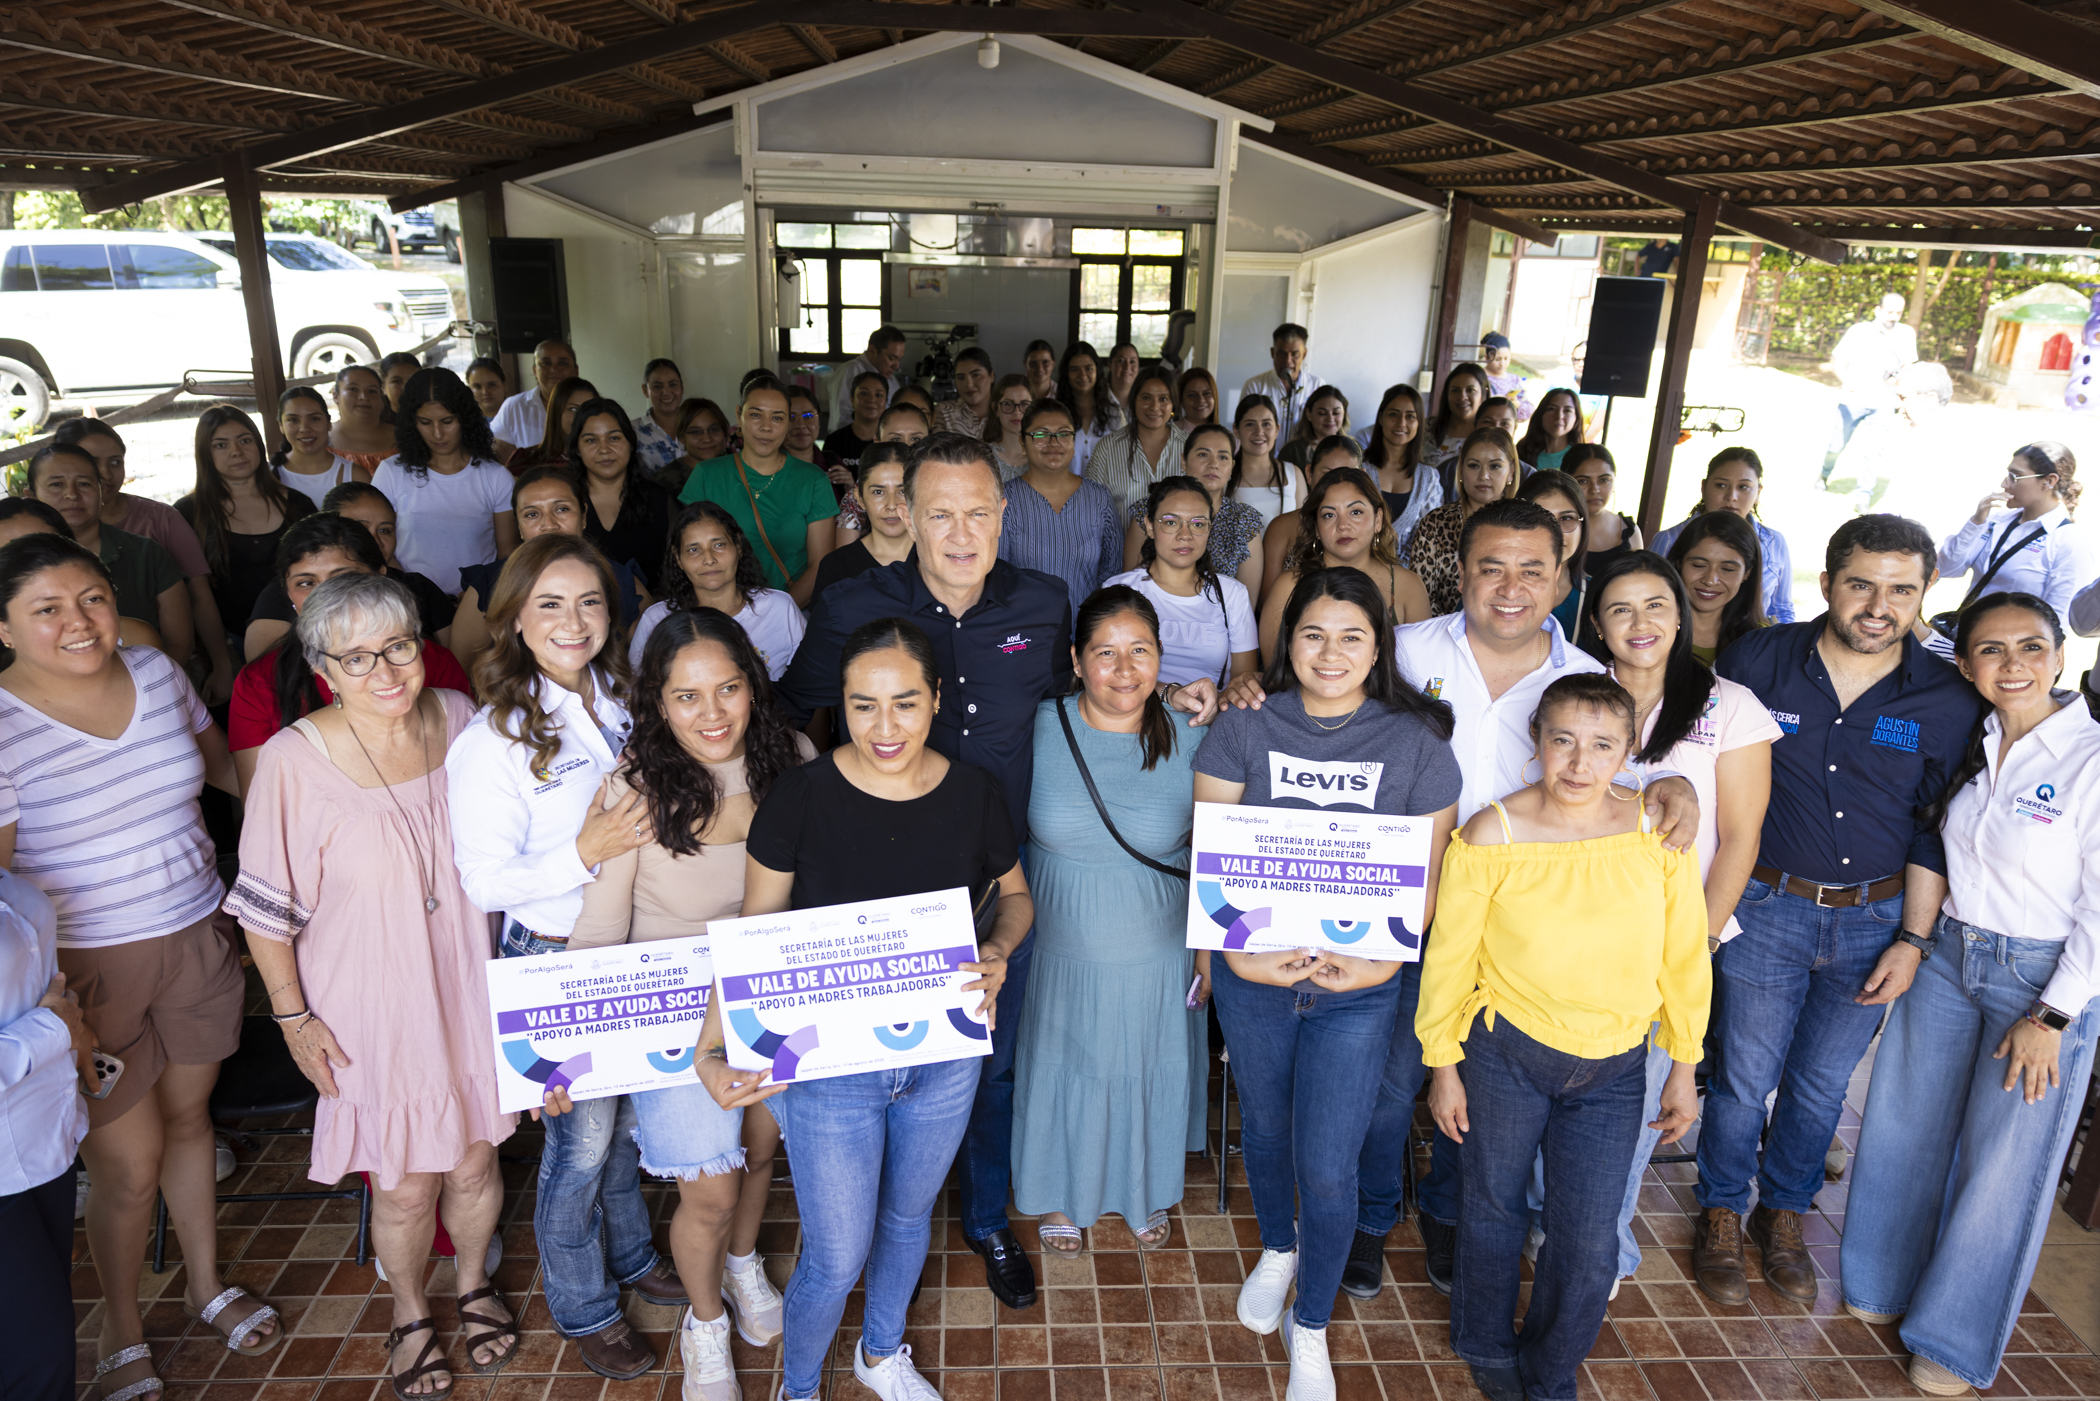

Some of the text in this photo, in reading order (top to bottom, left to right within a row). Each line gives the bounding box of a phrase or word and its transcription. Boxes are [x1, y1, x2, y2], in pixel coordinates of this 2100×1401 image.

[1007, 633, 1021, 643] AQUÍ
[1159, 620, 1217, 648] OVE
[1003, 643, 1027, 654] CONTIGO
[1777, 712, 1800, 725] CERCA
[1875, 715, 1920, 737] AGUSTÍN
[1871, 728, 1919, 749] DORANTES
[567, 759, 589, 770] MUJERES
[2016, 797, 2063, 816] QUERÉTARO
[1377, 825, 1411, 834] CONTIGO
[1255, 834, 1371, 850] SECRETARÍA DE LAS MUJERES
[1258, 845, 1366, 860] DEL ESTADO DE QUERÉTARO
[1220, 857, 1401, 883] VALE DE AYUDA SOCIAL
[1260, 880, 1267, 890] A
[1270, 881, 1311, 893] MADRES
[910, 902, 948, 916] CONTIGO
[692, 946, 710, 955] CON
[779, 929, 908, 954] SECRETARÍA DE LAS MUJERES
[786, 941, 905, 965] DEL ESTADO DE QUERÉTARO
[560, 966, 688, 990] SECRETARÍA DE LAS MUJERES
[747, 953, 950, 995] VALE DE AYUDA SOCIAL
[566, 977, 684, 1000] DEL ESTADO DE QUERÉTARO
[799, 995, 806, 1006] A
[808, 989, 854, 1004] MADRES
[524, 1007, 571, 1027] VALE
[602, 995, 662, 1017] AYUDA
[575, 1026, 582, 1036] A
[585, 1019, 631, 1034] MADRES
[633, 1009, 705, 1028] TRABAJADOR
